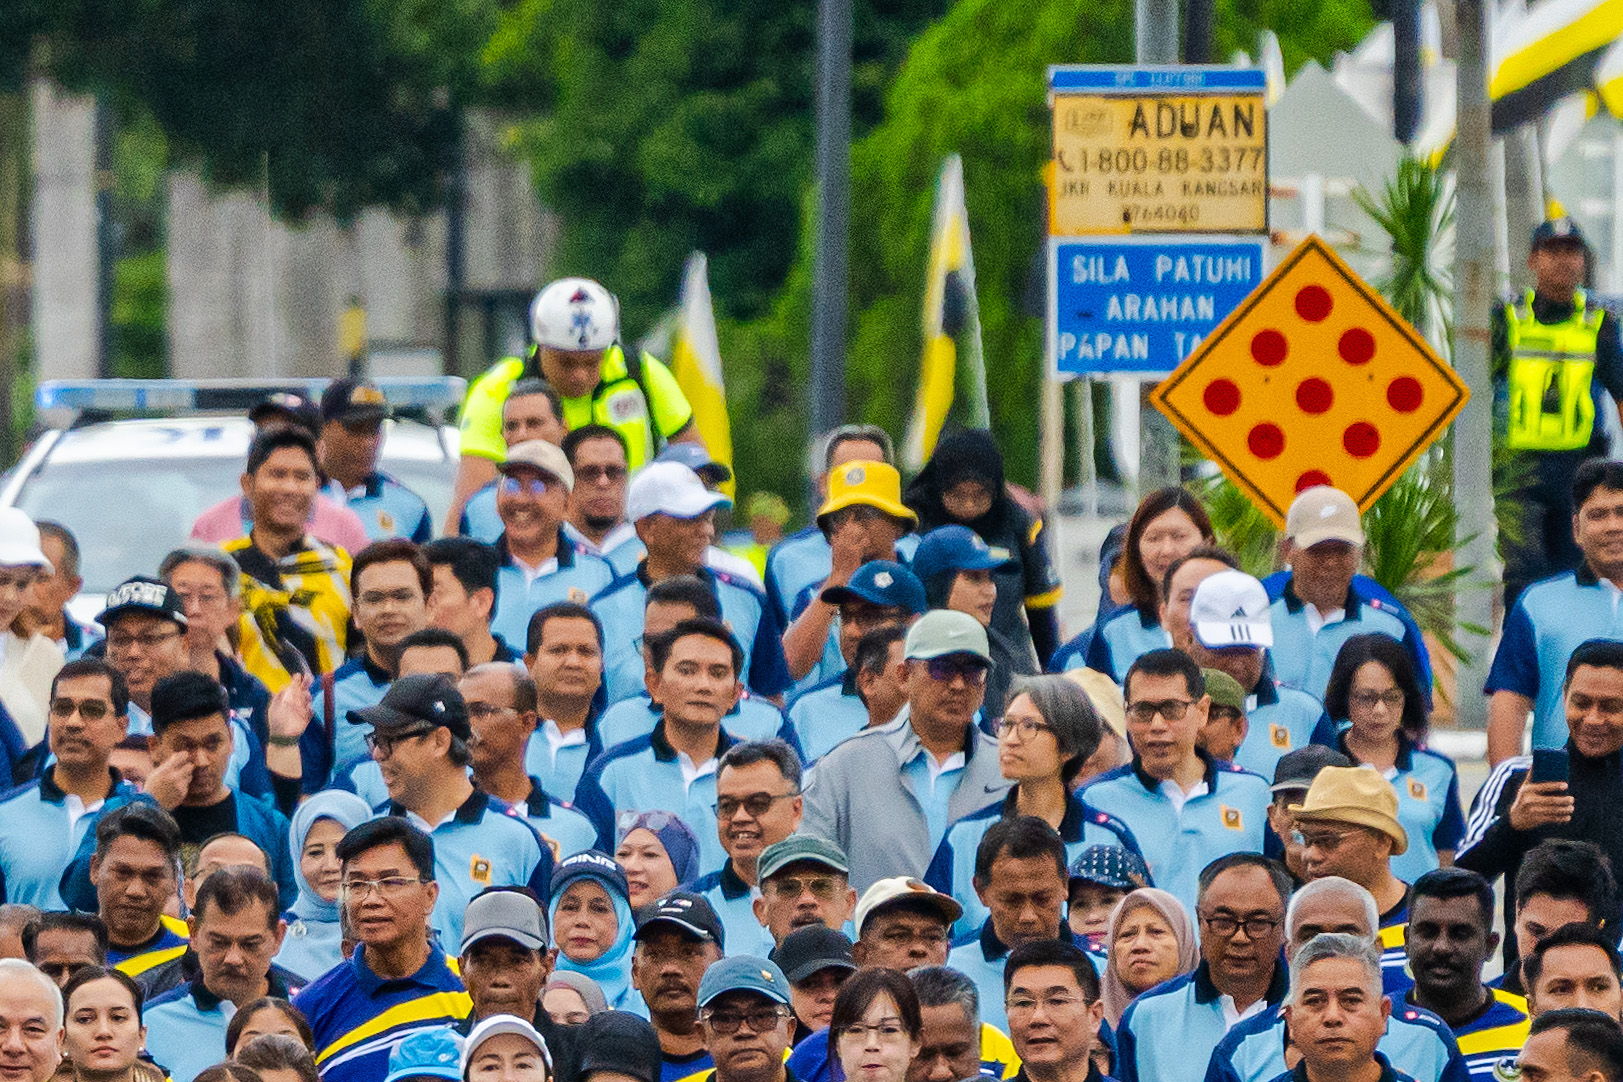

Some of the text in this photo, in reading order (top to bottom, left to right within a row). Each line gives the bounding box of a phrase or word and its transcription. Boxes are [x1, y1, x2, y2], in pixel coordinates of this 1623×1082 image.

[1130, 101, 1255, 139] ADUAN
[1107, 180, 1165, 198] KUALA
[1182, 180, 1263, 197] KANGSAR
[1072, 254, 1251, 284] SILA PATUHI
[1107, 294, 1214, 322] ARAHAN
[1059, 332, 1149, 361] PAPAN
